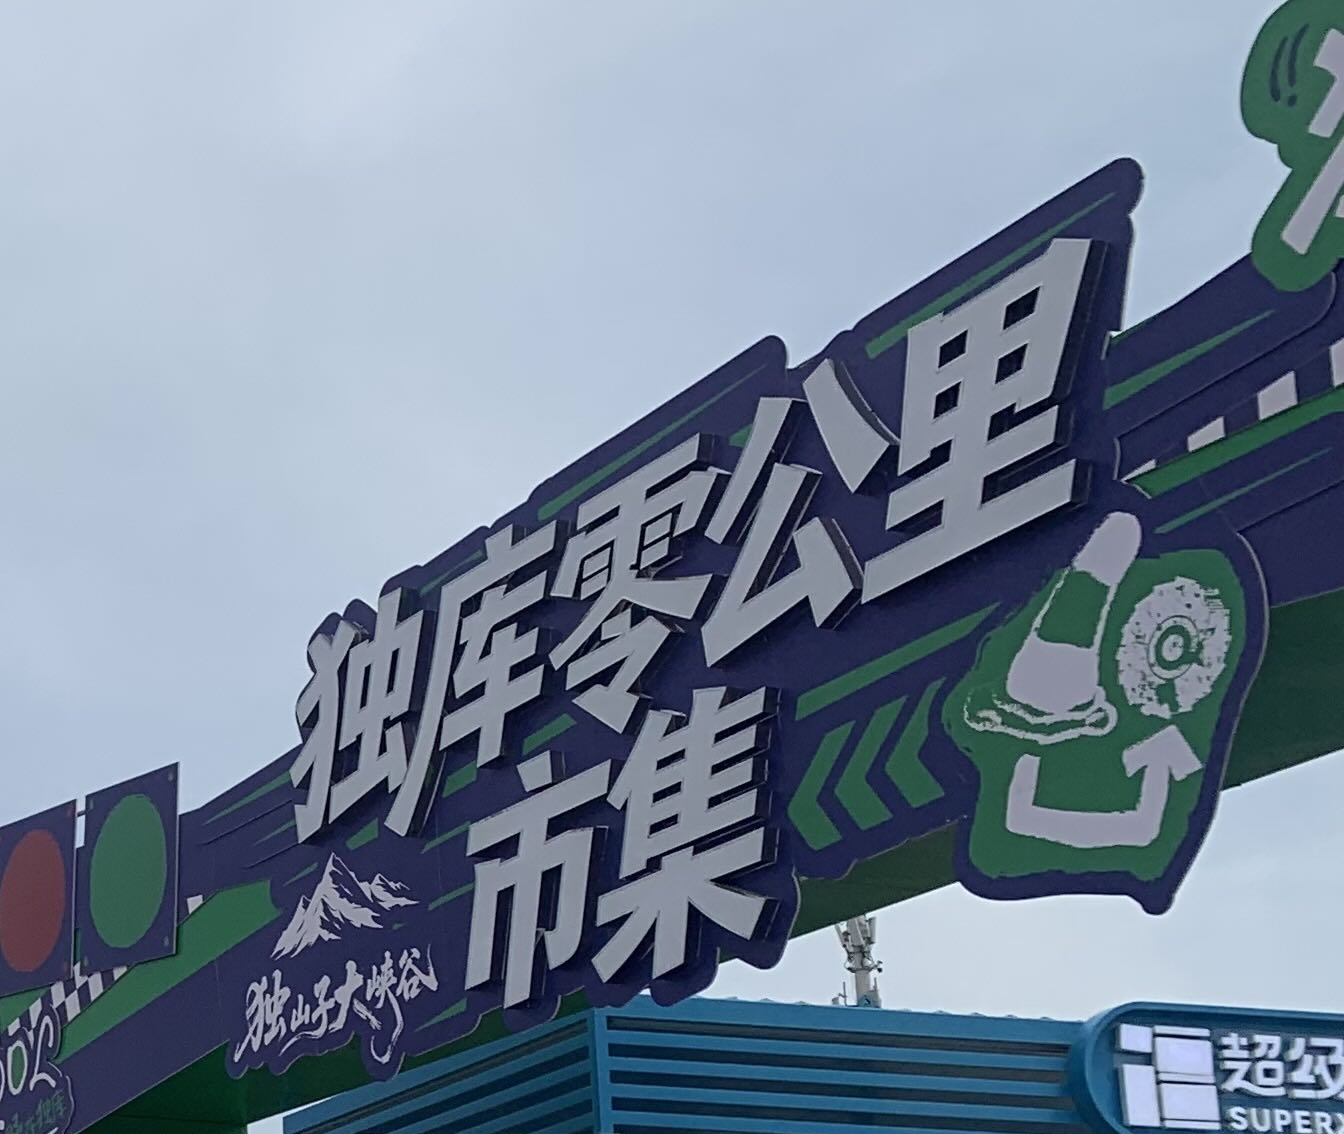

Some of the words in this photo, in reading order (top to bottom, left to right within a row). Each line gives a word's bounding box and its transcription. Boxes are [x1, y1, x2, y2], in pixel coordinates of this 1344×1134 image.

[293, 238, 1091, 843] 独库零公里
[465, 687, 777, 1008] 市集
[233, 944, 439, 1064] 独山子大峡谷
[1220, 1032, 1344, 1099] 超级
